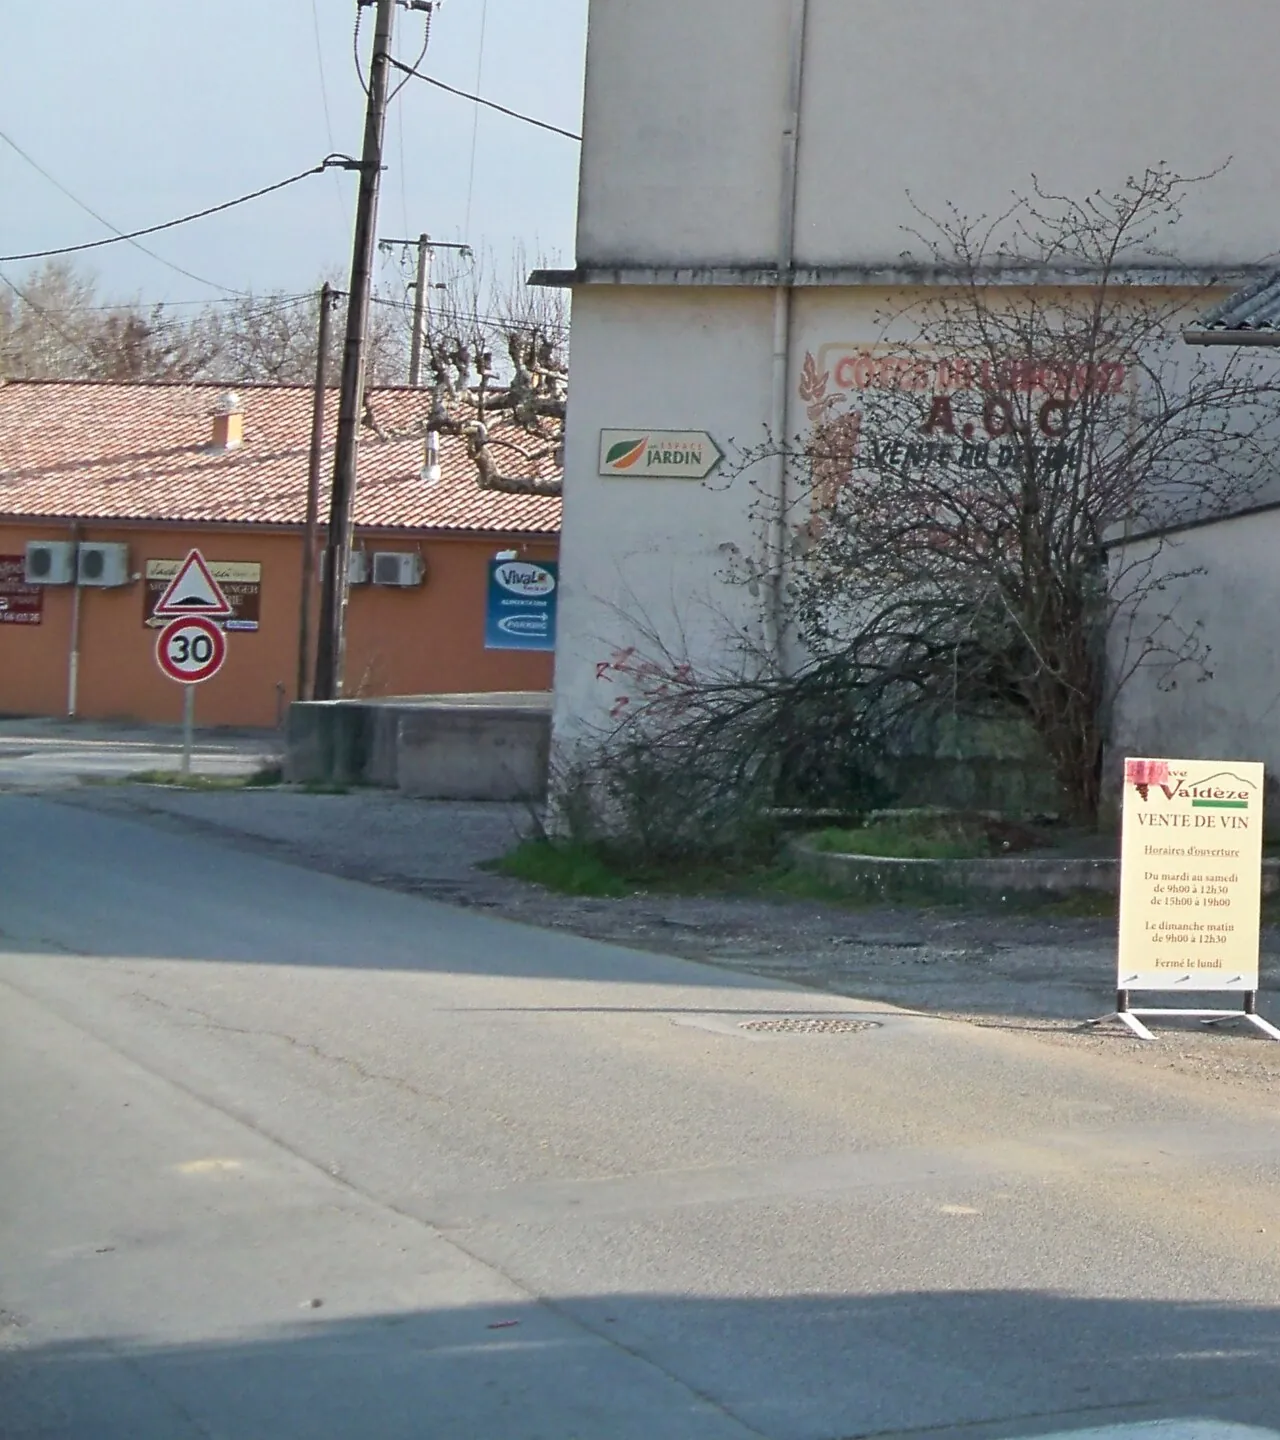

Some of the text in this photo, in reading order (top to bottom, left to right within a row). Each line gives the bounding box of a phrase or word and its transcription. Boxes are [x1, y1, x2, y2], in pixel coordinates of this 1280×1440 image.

[646, 450, 702, 467] JARDIN
[170, 634, 213, 664] 30
[1160, 779, 1249, 800] Valdèze
[1137, 813, 1249, 829] VENTE DE VIN
[1144, 845, 1240, 858] Horaires d'ouverture
[1144, 871, 1238, 883] Du mardi au samedi
[1153, 884, 1165, 893] de
[1167, 885, 1190, 894] 9h00
[1200, 885, 1228, 895] 12h30
[1150, 896, 1162, 905] de
[1165, 897, 1193, 906] 15h00
[1203, 898, 1231, 907] 19h00
[1145, 921, 1235, 932] Le dimanche matin
[1152, 933, 1163, 942] de
[1165, 934, 1189, 943] 9h00
[1199, 934, 1227, 944] 12h30
[1155, 958, 1222, 969] Fermé le lundi
